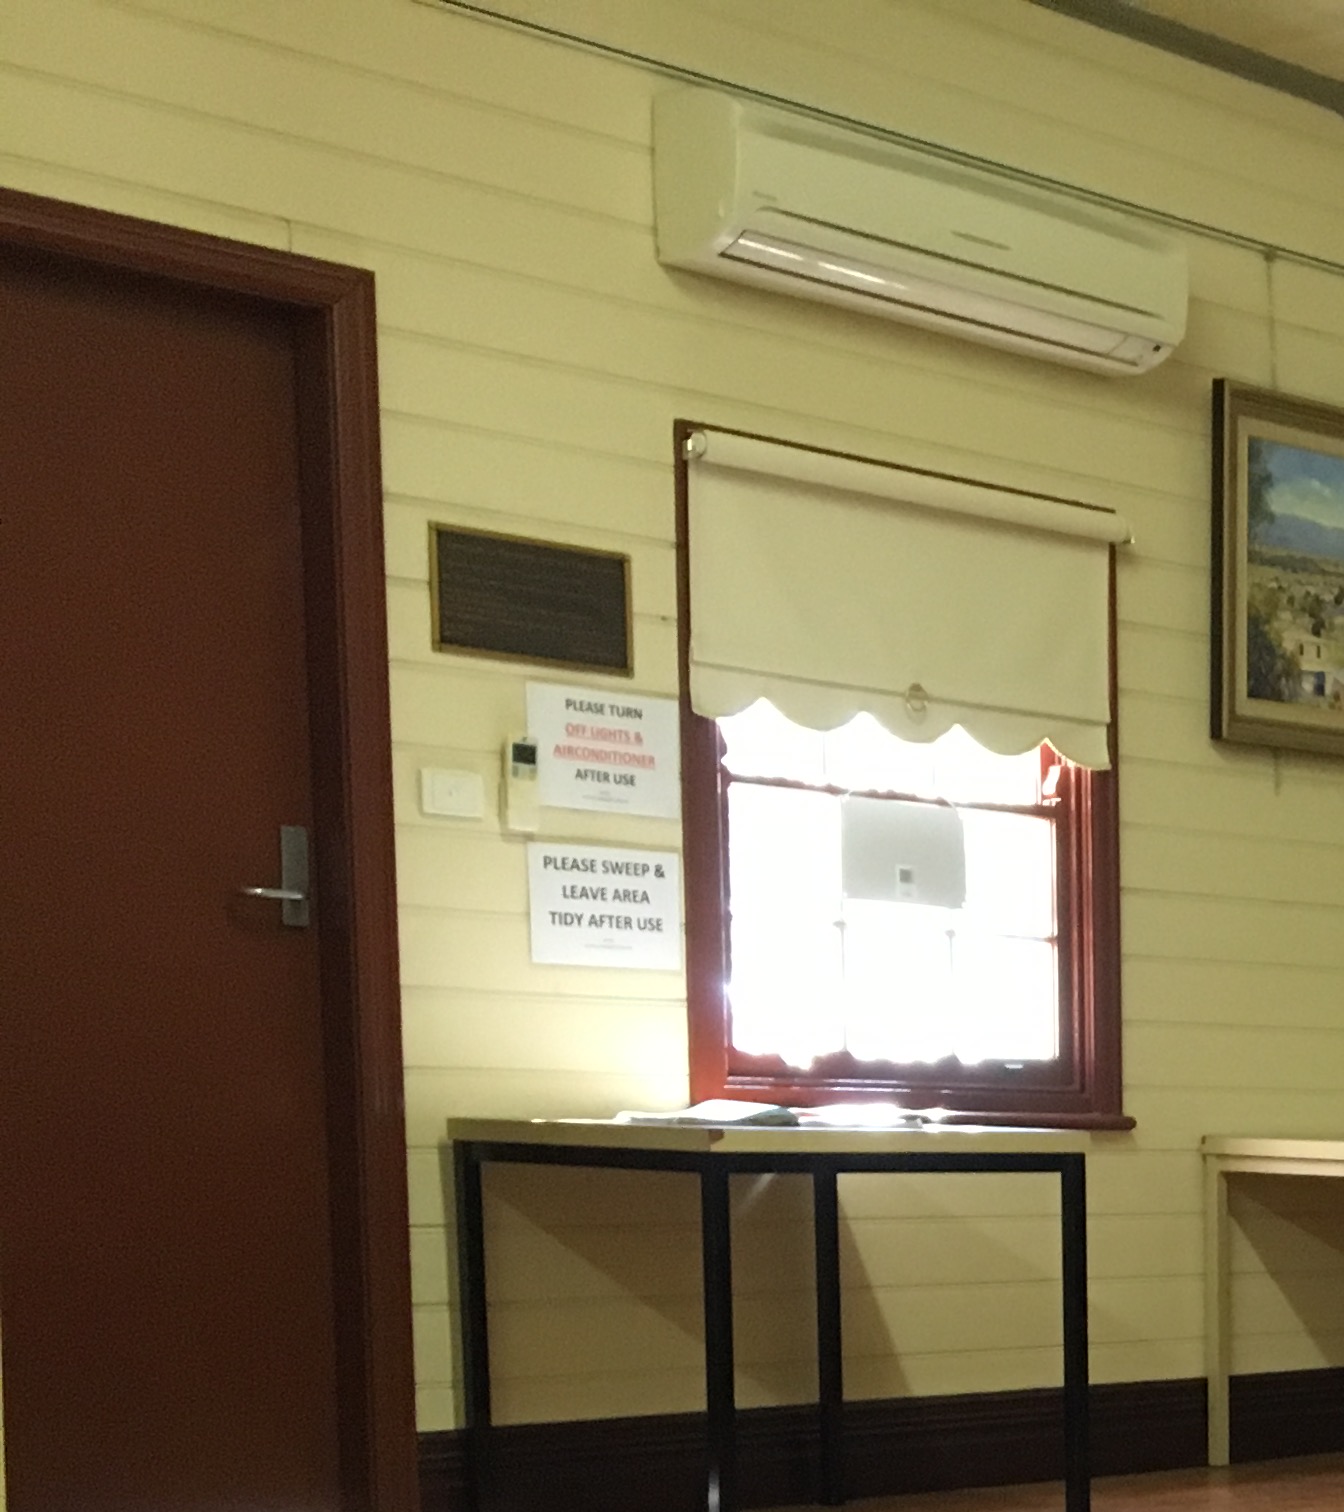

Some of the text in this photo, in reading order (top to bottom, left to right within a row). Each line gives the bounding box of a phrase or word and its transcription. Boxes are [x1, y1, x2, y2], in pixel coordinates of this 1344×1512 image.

[565, 699, 643, 720] PLEASE TURN
[565, 722, 587, 738] OFF
[590, 726, 631, 742] LIGHTS
[553, 744, 655, 769] AIRCONDITIONER
[575, 768, 636, 787] AFTER USE
[543, 855, 665, 878] PLEASE SWEEP &
[562, 885, 650, 904] LEAVE AREA
[549, 911, 663, 932] TIDY AFTER USE
